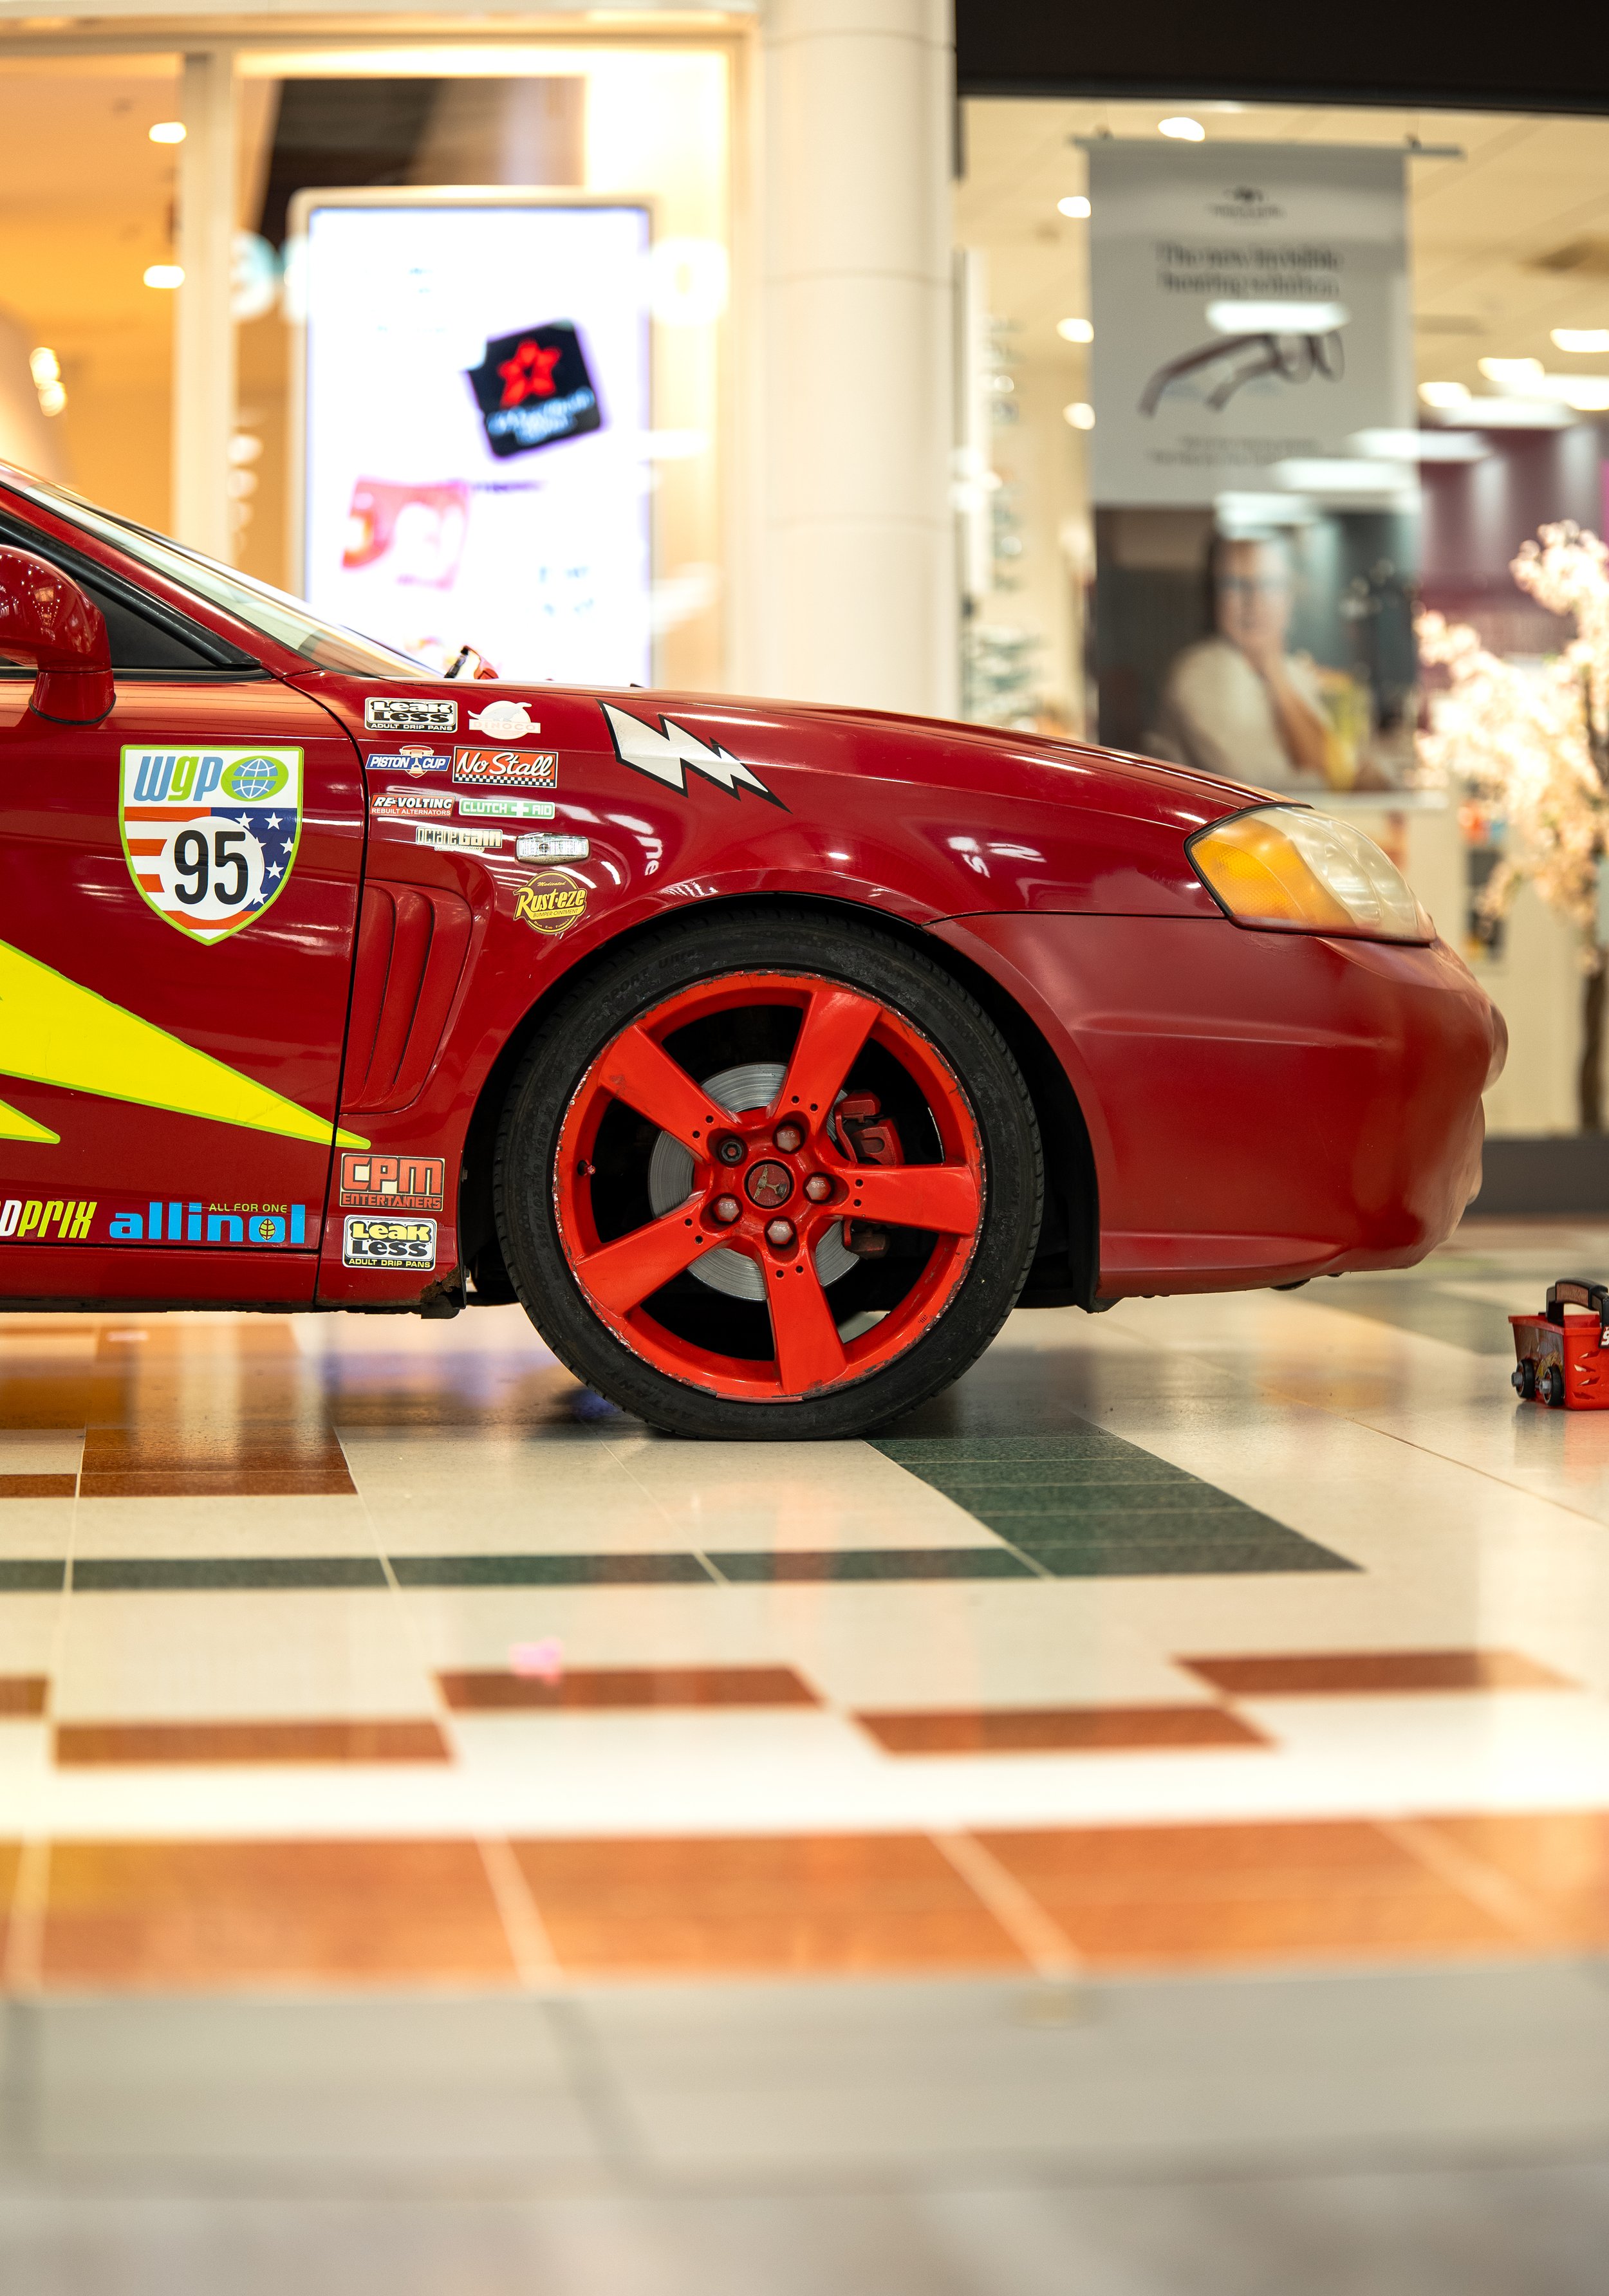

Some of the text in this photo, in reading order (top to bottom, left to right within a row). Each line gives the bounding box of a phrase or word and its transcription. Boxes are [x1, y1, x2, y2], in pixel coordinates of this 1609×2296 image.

[473, 721, 535, 731] DINOCO
[370, 756, 447, 768] PISTON CUP
[454, 751, 555, 777] No Stall
[133, 755, 223, 802] wgp
[374, 797, 453, 809] RE-VOLTING
[463, 801, 553, 815] CLUTCH AID
[174, 829, 248, 905] 95
[343, 1154, 443, 1195] CPM
[209, 1203, 288, 1213] ALL FOR ONE
[342, 1193, 442, 1209] ENTERTAINERS
[109, 1201, 306, 1244] allinol
